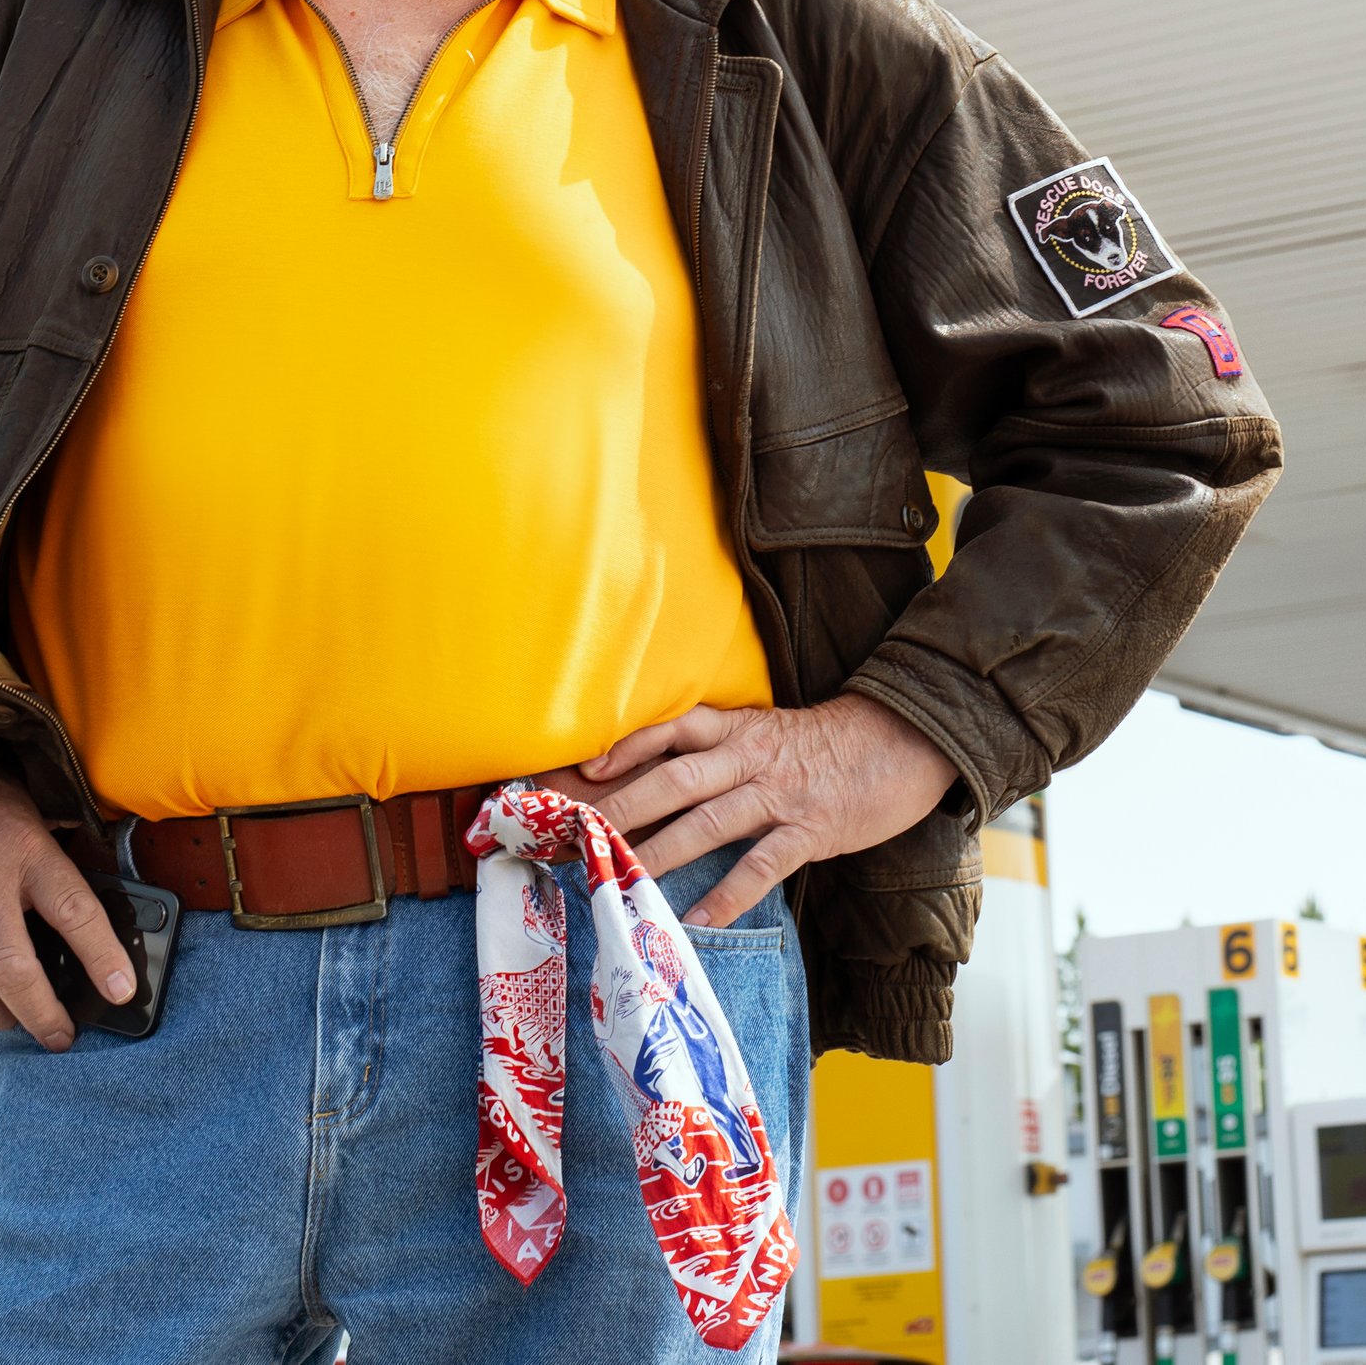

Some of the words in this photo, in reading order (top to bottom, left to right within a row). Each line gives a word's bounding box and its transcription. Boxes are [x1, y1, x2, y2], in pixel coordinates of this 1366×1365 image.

[1034, 176, 1078, 234] RESCUE
[1079, 175, 1127, 205] DOGS
[1083, 250, 1149, 291] FOREVER
[1223, 930, 1254, 976] 6
[736, 1224, 796, 1328] HANDS
